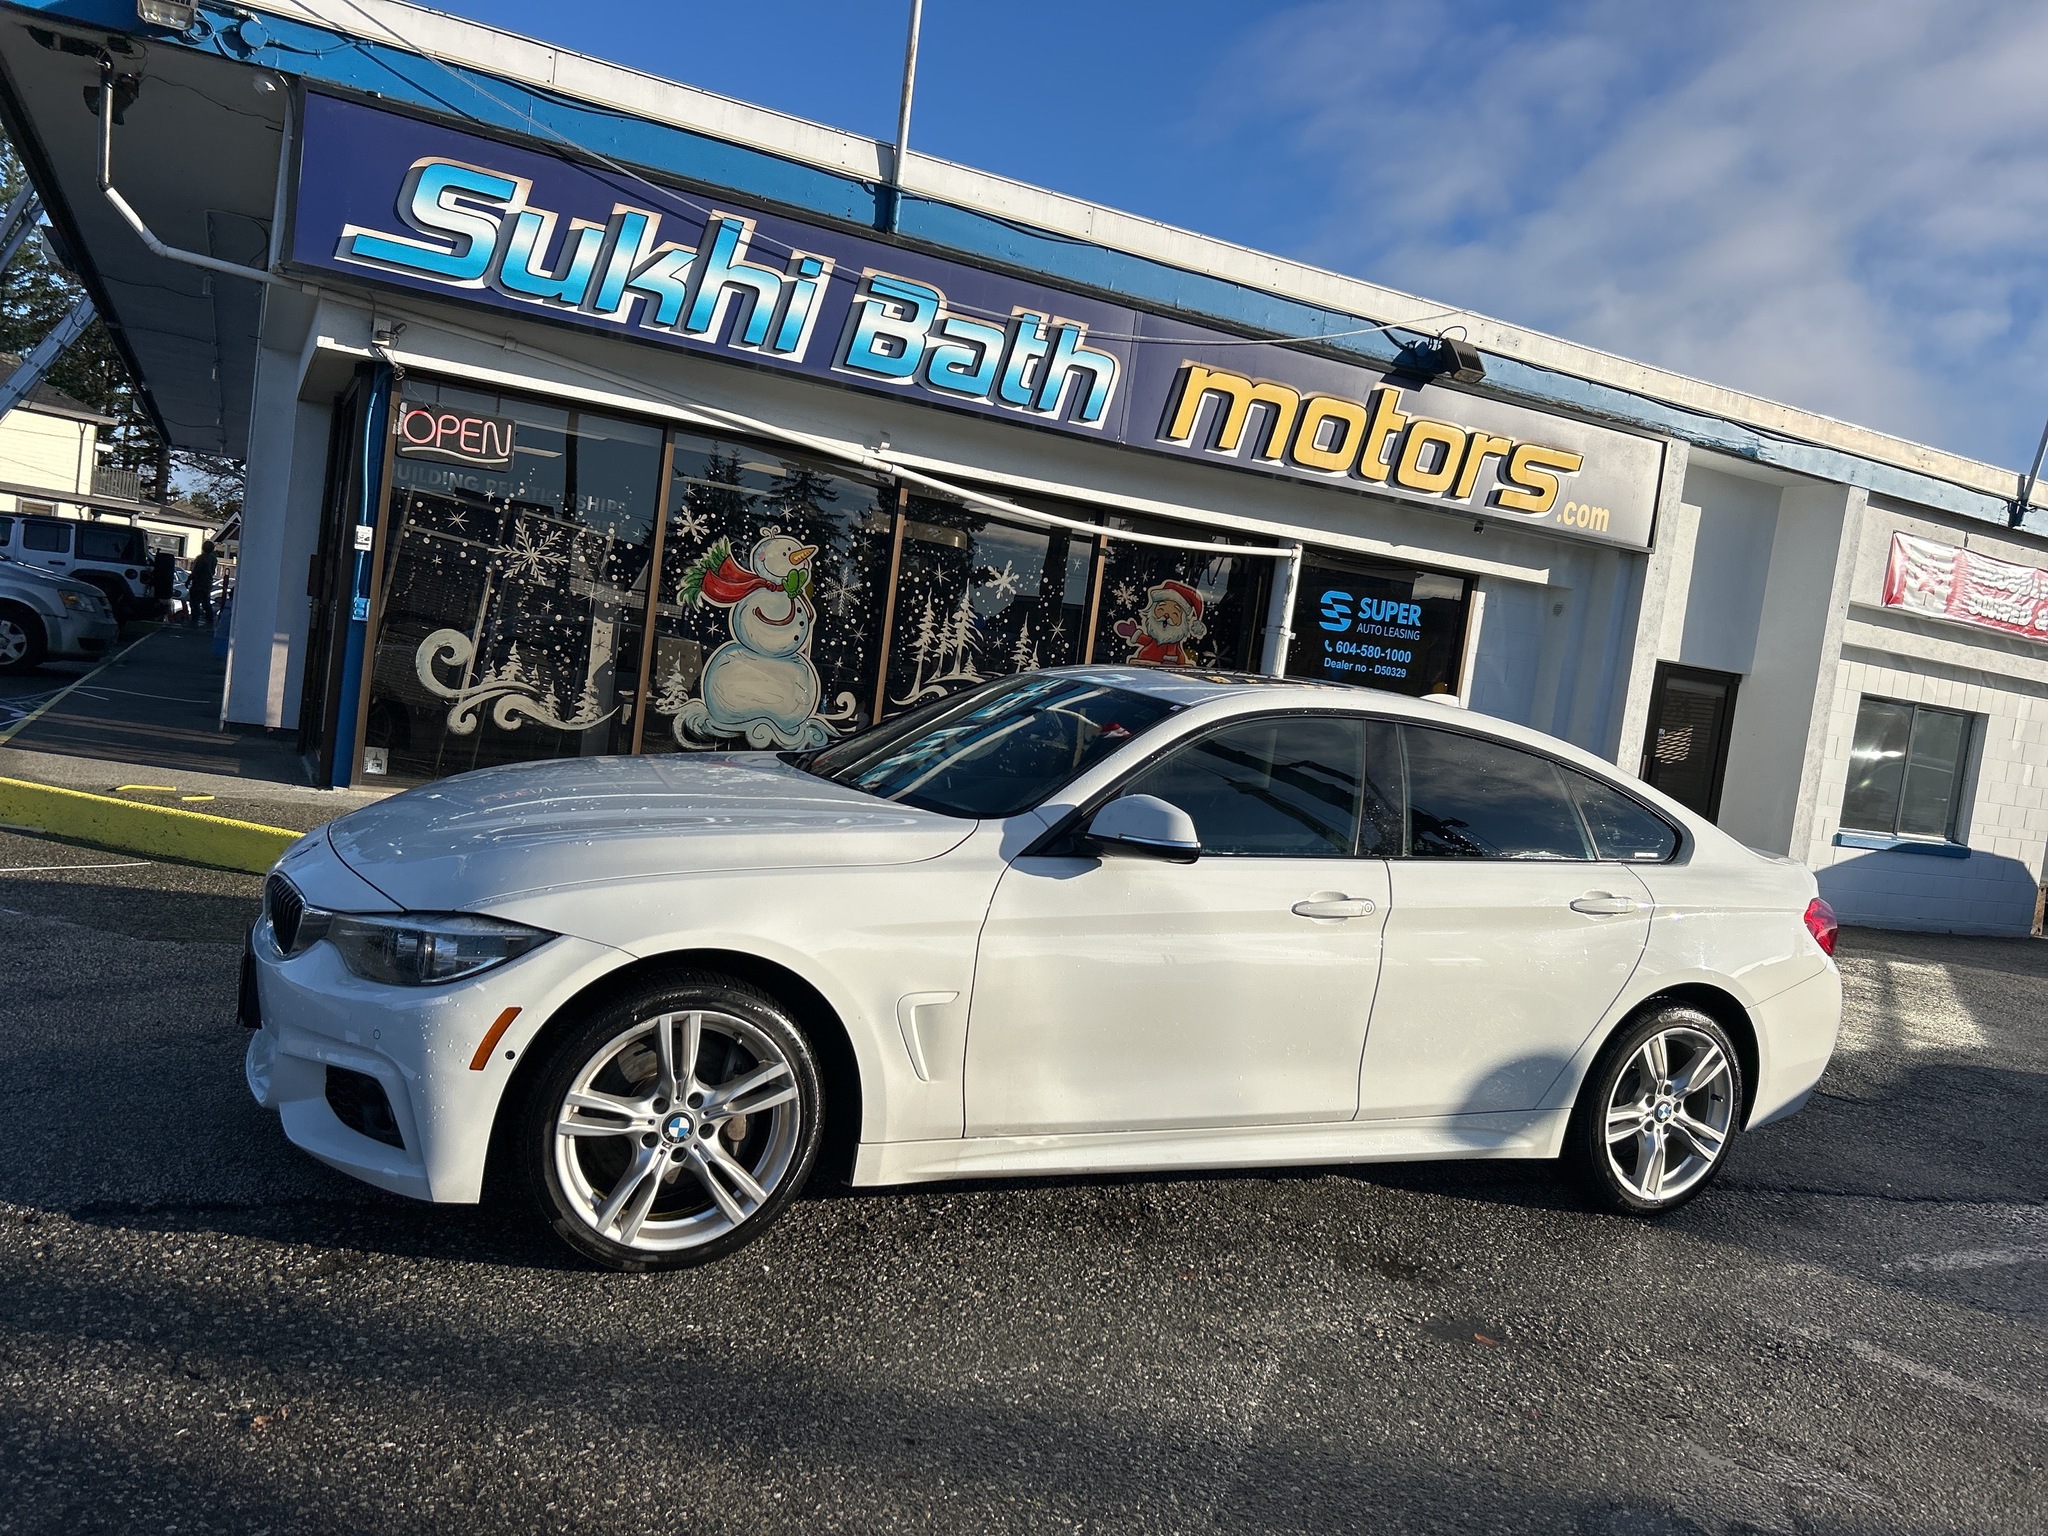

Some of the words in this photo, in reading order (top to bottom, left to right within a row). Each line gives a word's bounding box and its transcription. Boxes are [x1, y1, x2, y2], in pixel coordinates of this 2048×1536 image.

[334, 156, 835, 363] Sukhi
[830, 266, 1121, 430] Bath
[1156, 359, 1584, 518] motors
[403, 409, 512, 457] OPEN
[1358, 597, 1421, 627] SUPER
[1356, 623, 1382, 636] AUTO
[1383, 626, 1420, 641] LEASING
[1335, 641, 1412, 663] 604-580-1000
[1324, 657, 1354, 670] Dealer
[1374, 664, 1407, 678] D50329
